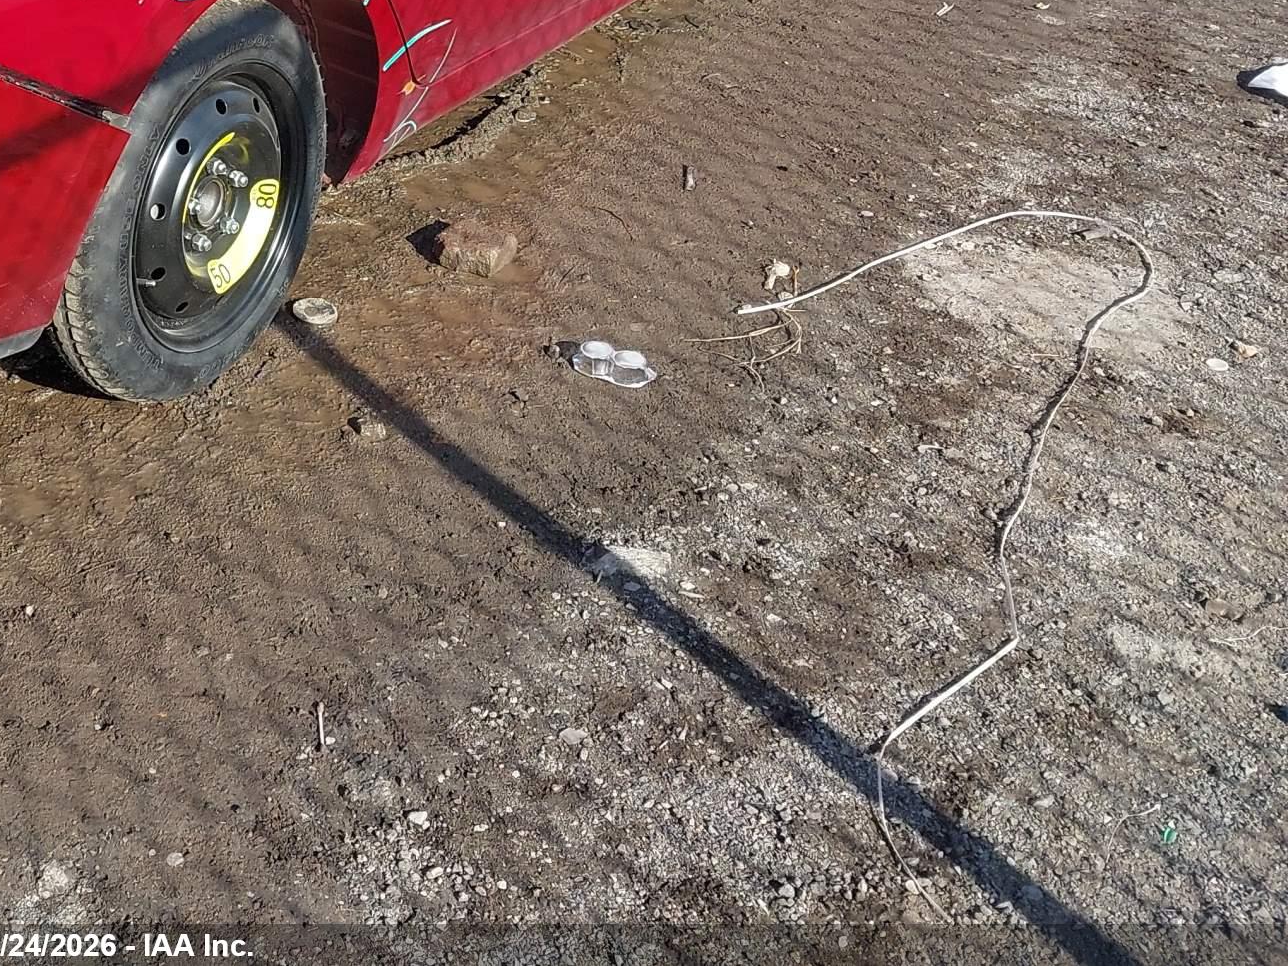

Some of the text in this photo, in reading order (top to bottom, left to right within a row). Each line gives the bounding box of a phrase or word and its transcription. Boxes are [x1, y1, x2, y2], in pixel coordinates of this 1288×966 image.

[118, 197, 135, 251] USE
[130, 121, 162, 194] ONLY
[255, 182, 278, 210] 80
[210, 263, 232, 290] 50
